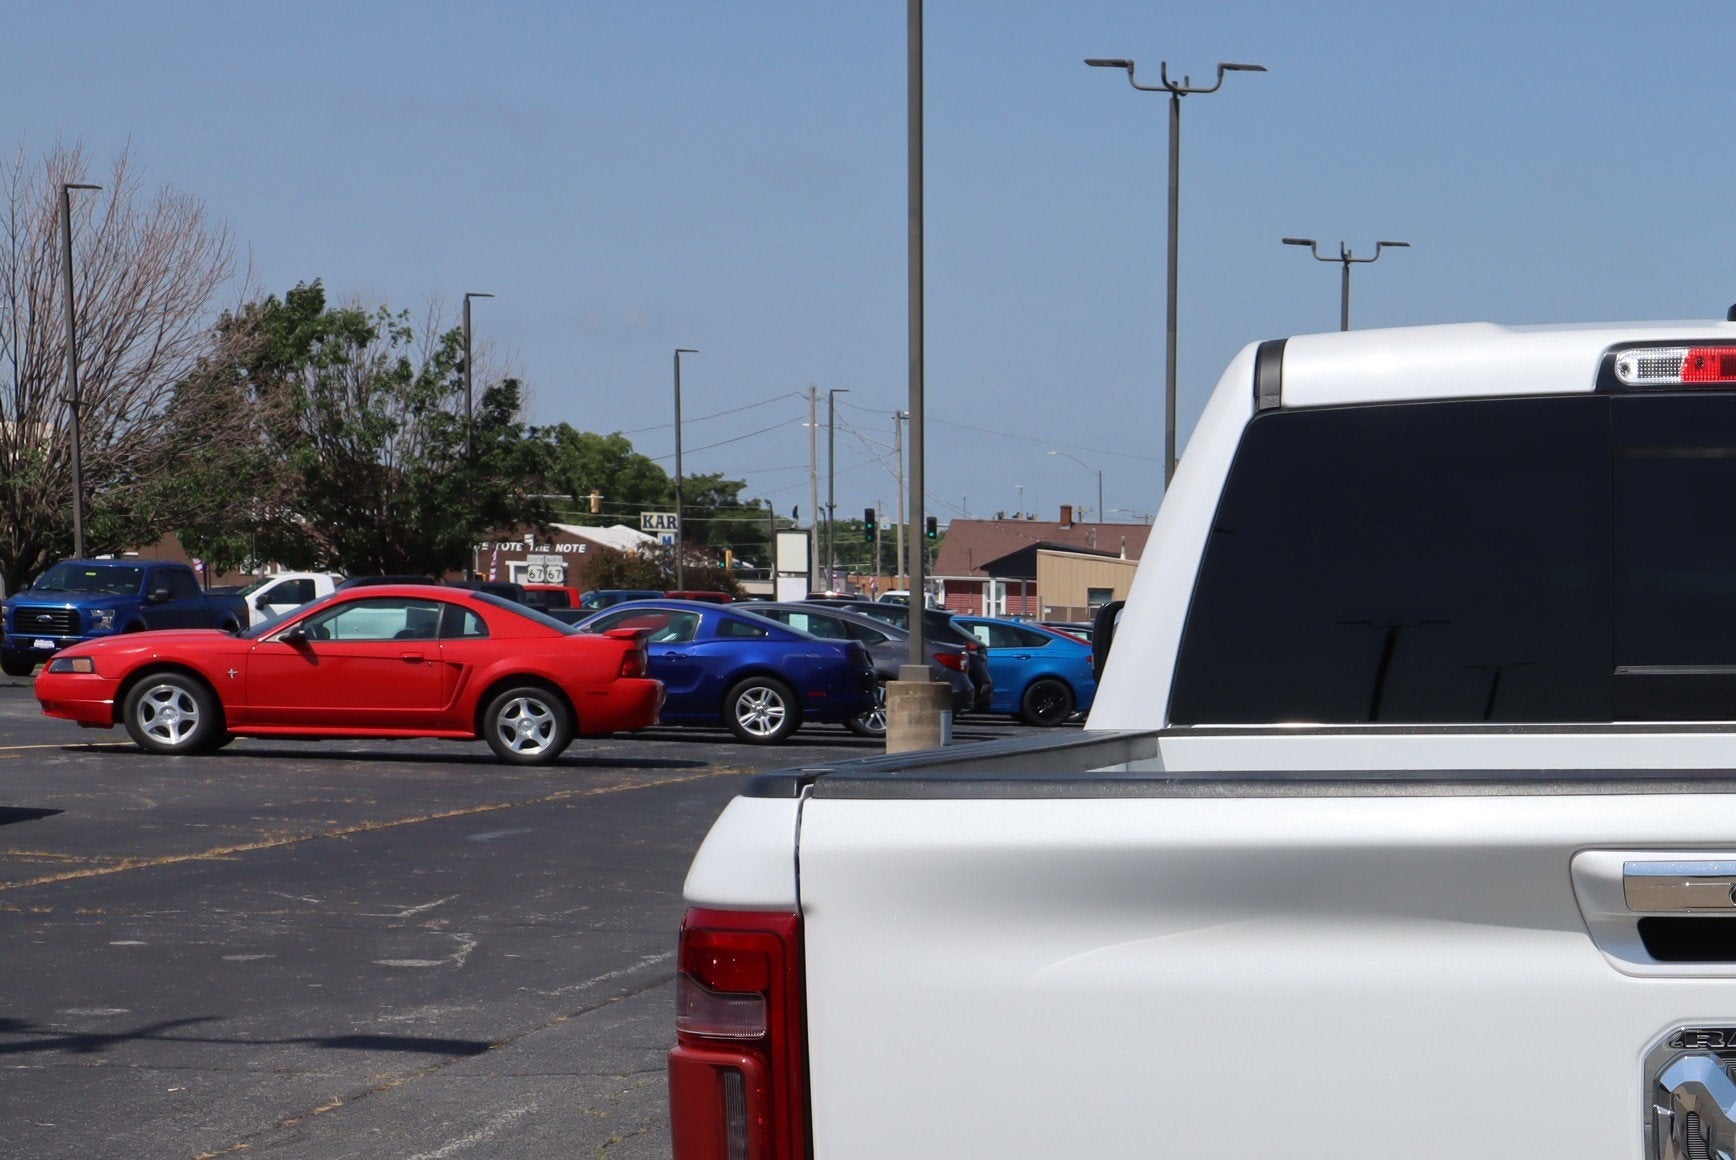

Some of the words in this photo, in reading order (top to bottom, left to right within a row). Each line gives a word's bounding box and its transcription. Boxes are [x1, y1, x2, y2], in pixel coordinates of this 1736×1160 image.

[642, 514, 678, 529] KAR
[555, 543, 587, 553] NOTE
[529, 568, 543, 579] 67
[548, 569, 561, 580] 67
